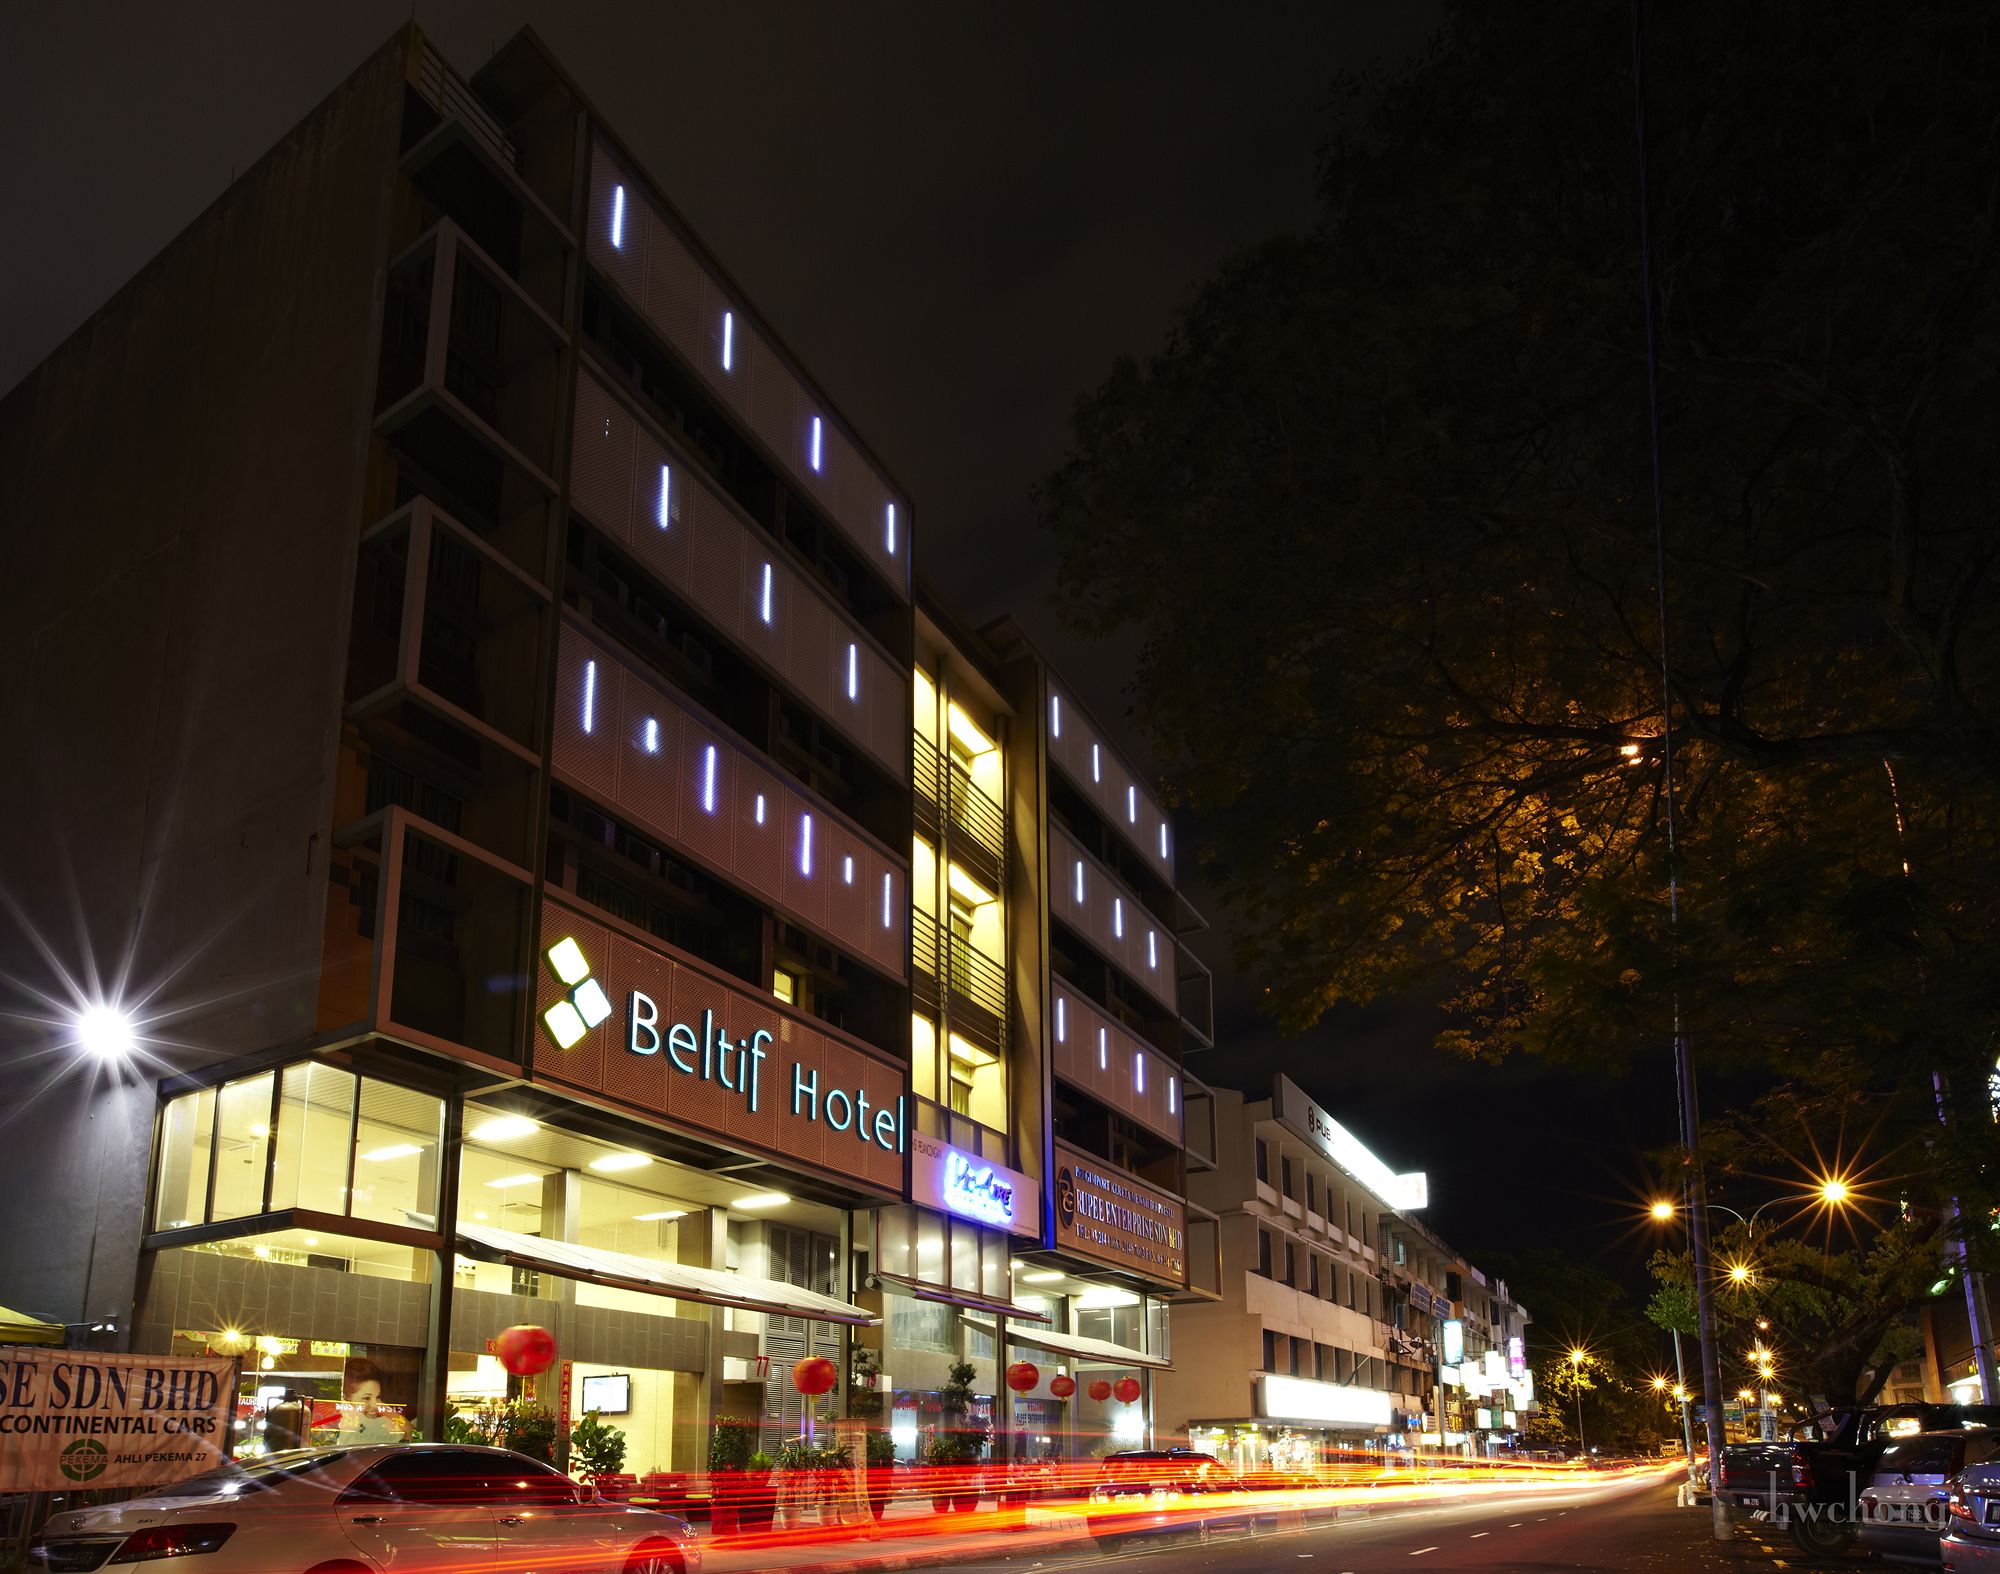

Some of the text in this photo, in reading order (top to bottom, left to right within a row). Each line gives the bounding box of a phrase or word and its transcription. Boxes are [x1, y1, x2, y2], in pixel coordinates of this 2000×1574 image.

[630, 990, 904, 1153] Beltif Hotel
[1075, 1188, 1183, 1251] RUPEE ENTERPRISE SDN BHD
[754, 1355, 769, 1377] 77
[49, 1362, 136, 1411] SDN
[139, 1368, 219, 1411] BHD
[1, 1414, 217, 1434] CONTINENTAL CARS
[59, 1455, 108, 1465] PEKEMA
[114, 1452, 207, 1464] AHLI PEKEMA 27
